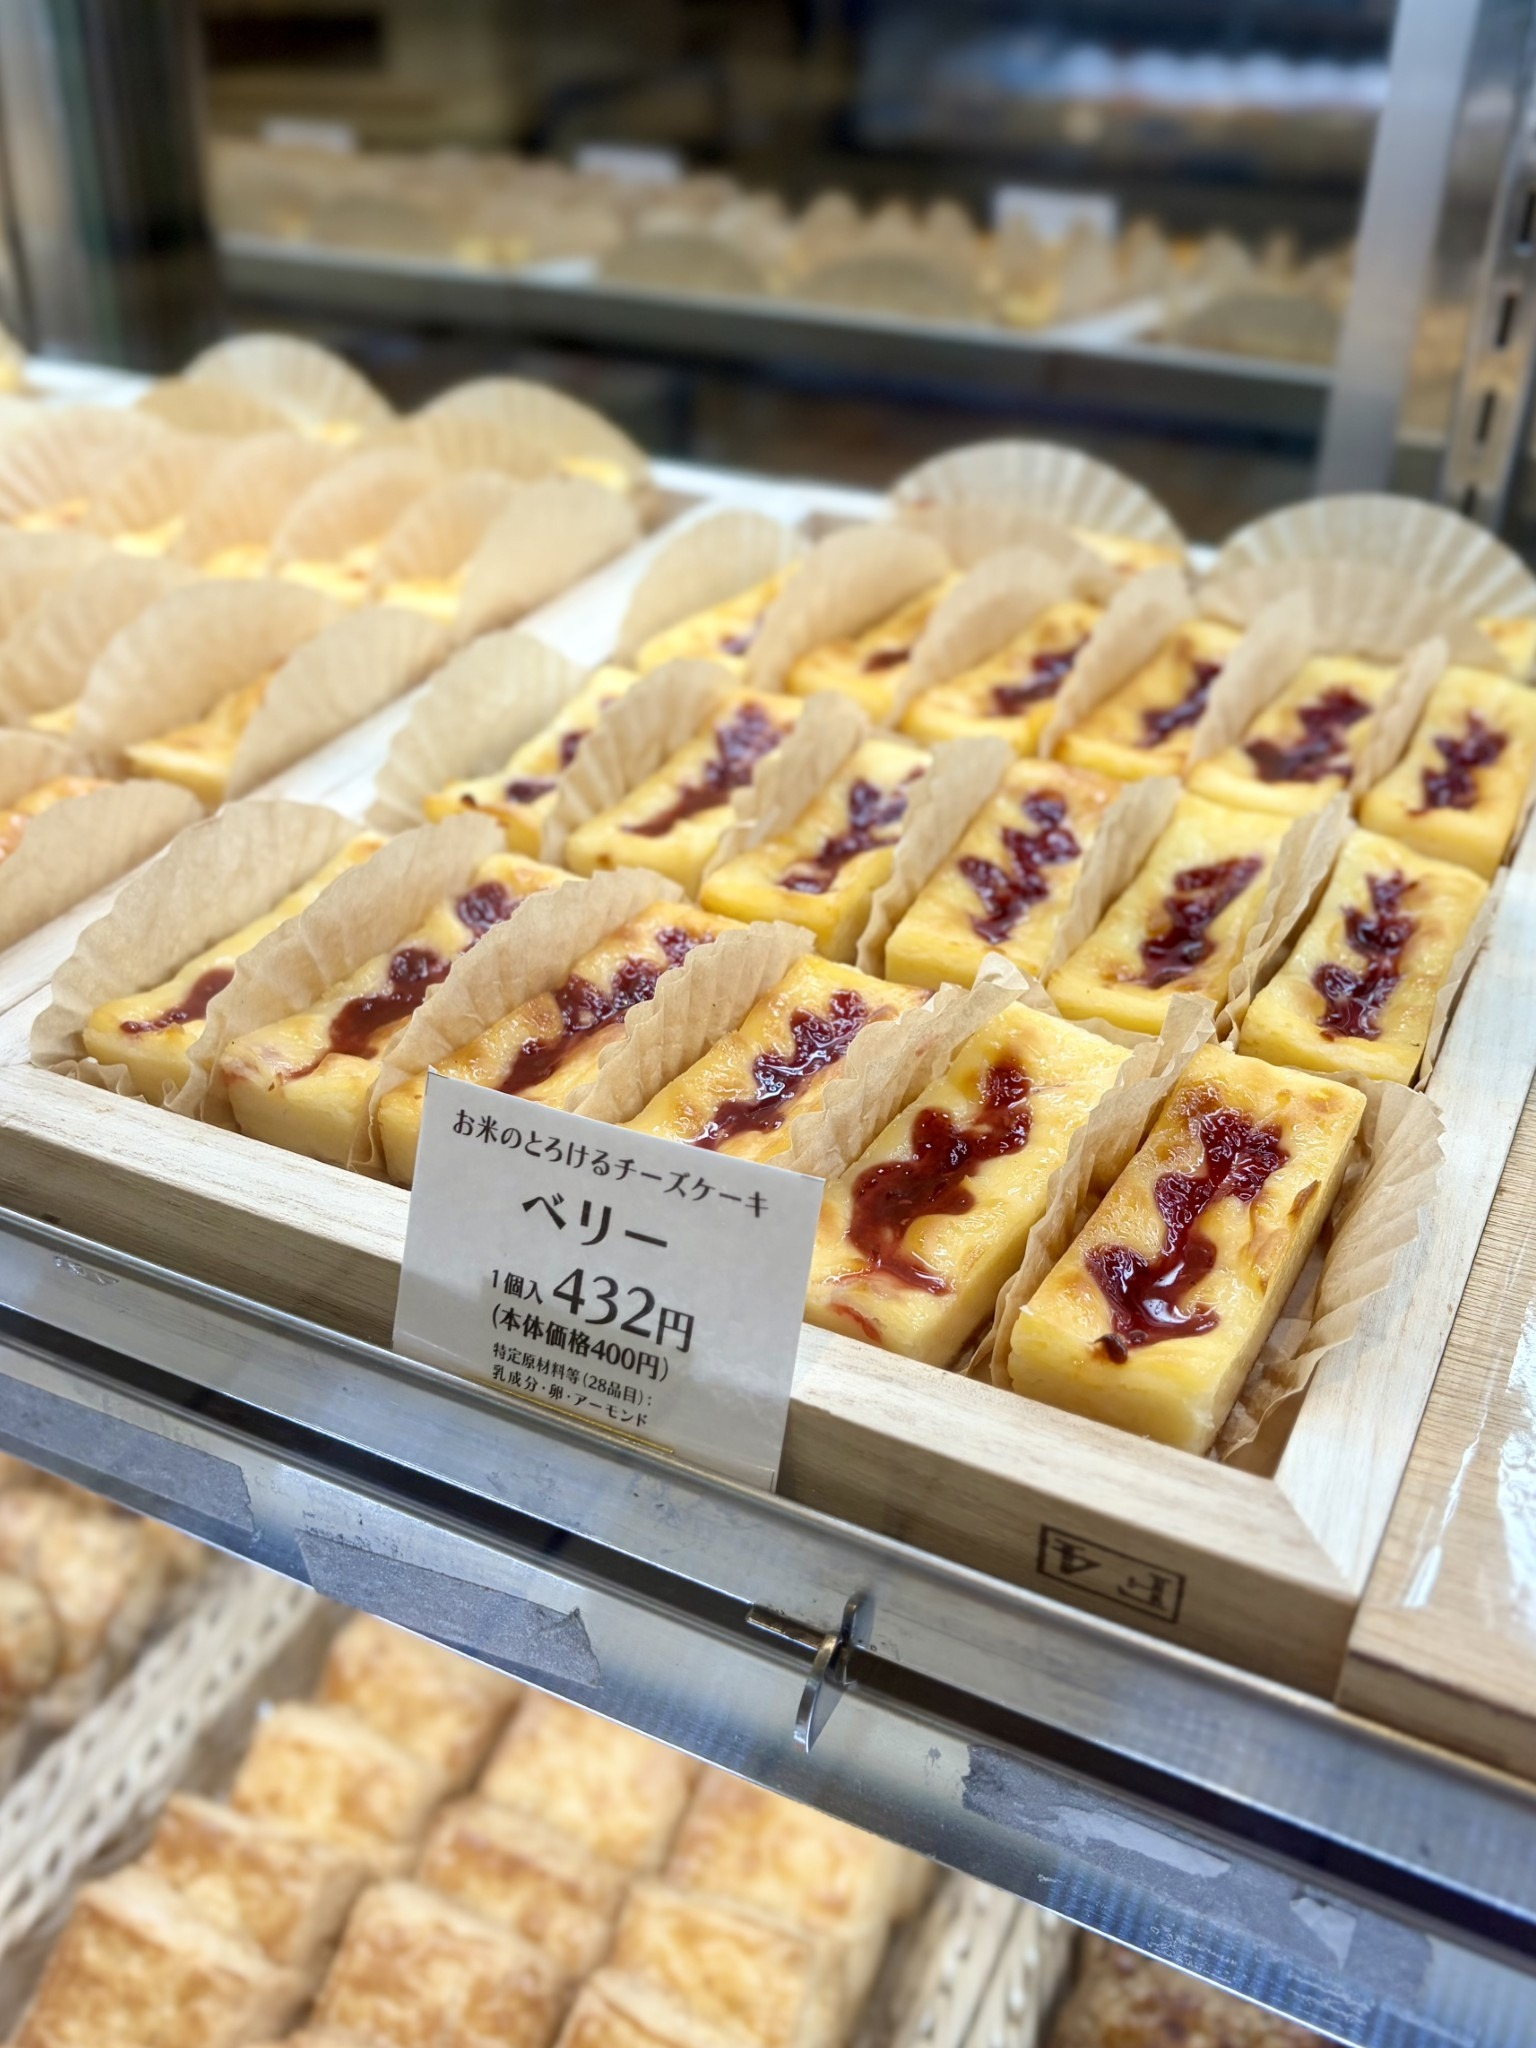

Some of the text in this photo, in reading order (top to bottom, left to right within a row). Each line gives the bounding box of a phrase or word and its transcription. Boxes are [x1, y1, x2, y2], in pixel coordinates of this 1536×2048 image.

[452, 1109, 769, 1218] お米のとろけるチーズケーキ
[521, 1192, 668, 1248] ベリー
[492, 1303, 669, 1382] (本体価格400円)
